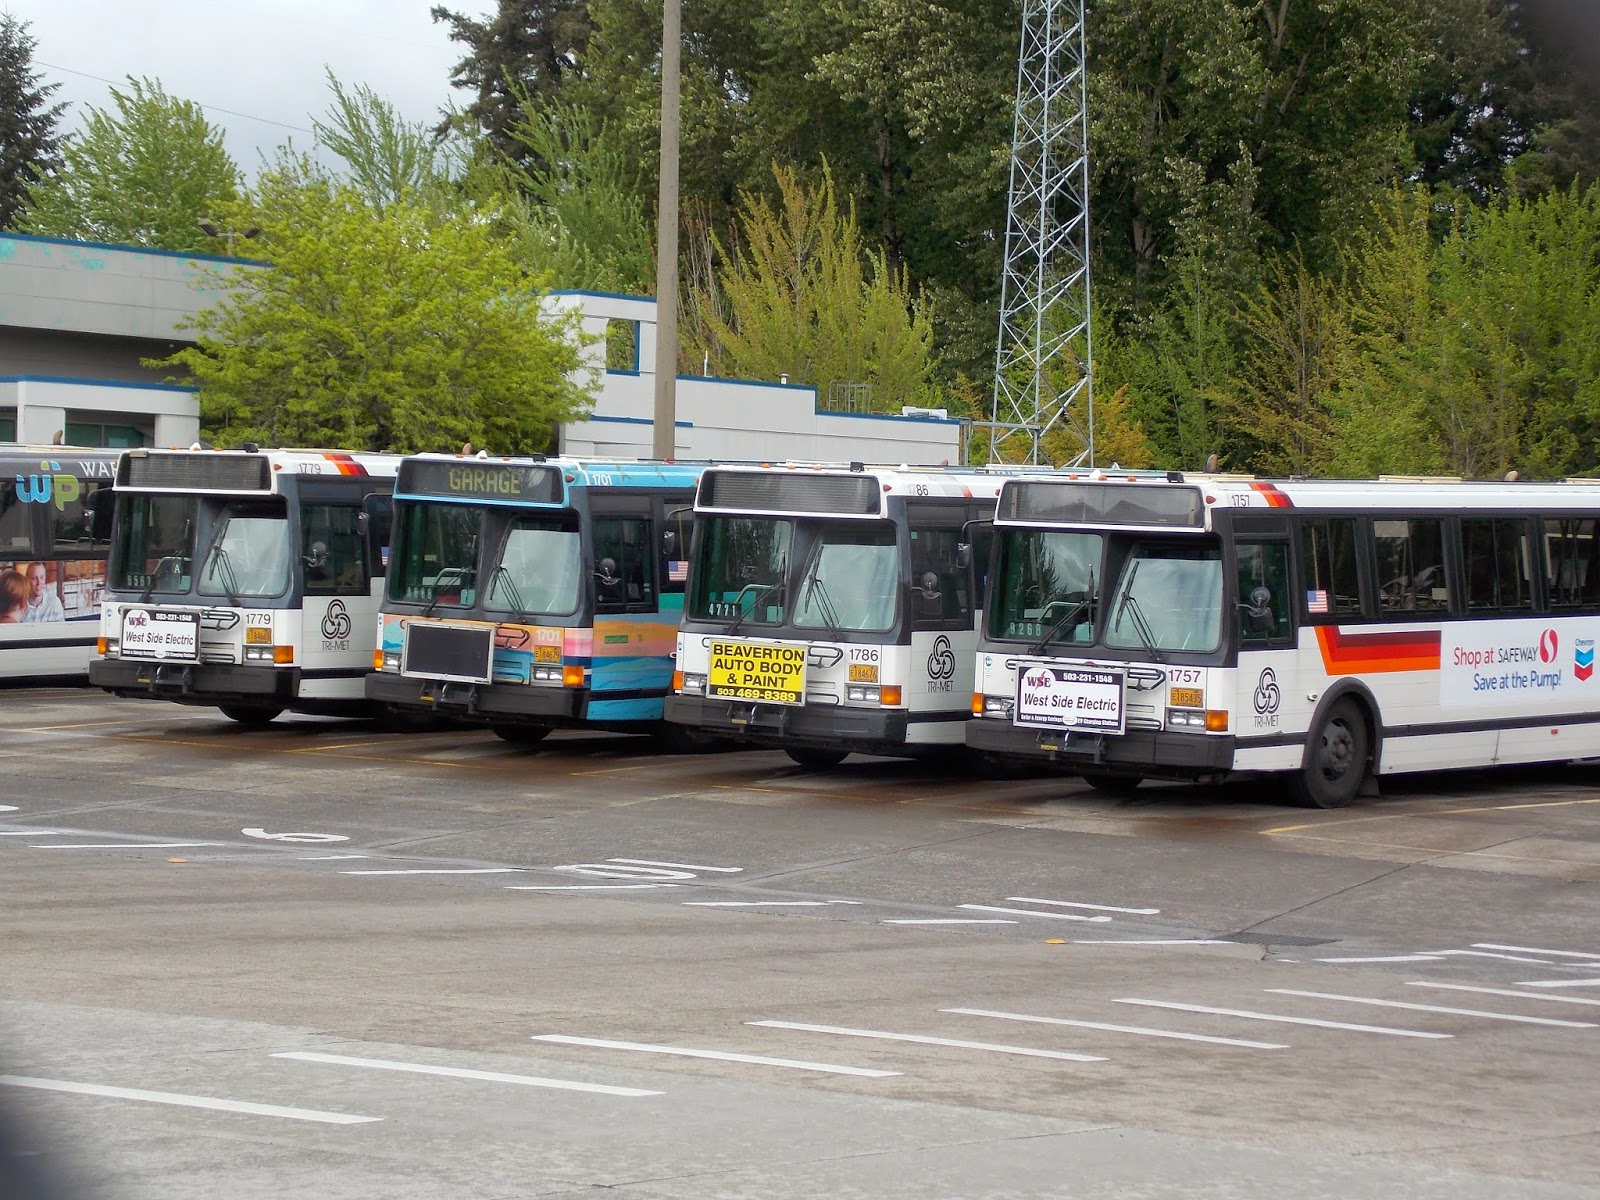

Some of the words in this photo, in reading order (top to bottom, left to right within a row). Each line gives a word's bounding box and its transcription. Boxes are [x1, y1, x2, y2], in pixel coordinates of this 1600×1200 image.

[298, 463, 321, 475] 1779
[449, 467, 521, 494] GARAGE
[592, 474, 613, 486] 1701
[1231, 494, 1250, 507] 1757
[708, 603, 736, 617] 4771
[246, 613, 271, 625] 1779
[536, 628, 560, 642] 1701
[1009, 622, 1042, 636] 9268
[126, 631, 144, 642] West
[147, 632, 164, 644] Side
[165, 633, 194, 646] Electric
[322, 640, 351, 651] TRI-MET
[1575, 638, 1594, 647] Chevron
[713, 643, 805, 662] BEAVERTON
[849, 648, 879, 662] 1786
[1453, 646, 1482, 669] Shop
[1484, 647, 1495, 664] at
[1498, 647, 1539, 663] SAFEWAY
[713, 658, 755, 672] AUTO
[760, 661, 803, 675] BODY
[726, 673, 738, 685] &
[743, 674, 788, 688] PAINT
[1027, 671, 1052, 690] WSE
[1063, 672, 1113, 683] 503-231-1548
[1168, 669, 1201, 682] 1757
[1473, 673, 1497, 691] Save
[1499, 673, 1509, 689] at
[1512, 671, 1528, 688] the
[1530, 669, 1562, 690] Pump!
[927, 681, 954, 693] TRI-MET
[716, 688, 735, 696] 503
[736, 688, 797, 702] 469-8389
[1024, 693, 1048, 707] West
[1051, 695, 1074, 709] Side
[1076, 696, 1117, 712] Electric
[1254, 715, 1279, 727] TRI-MET
